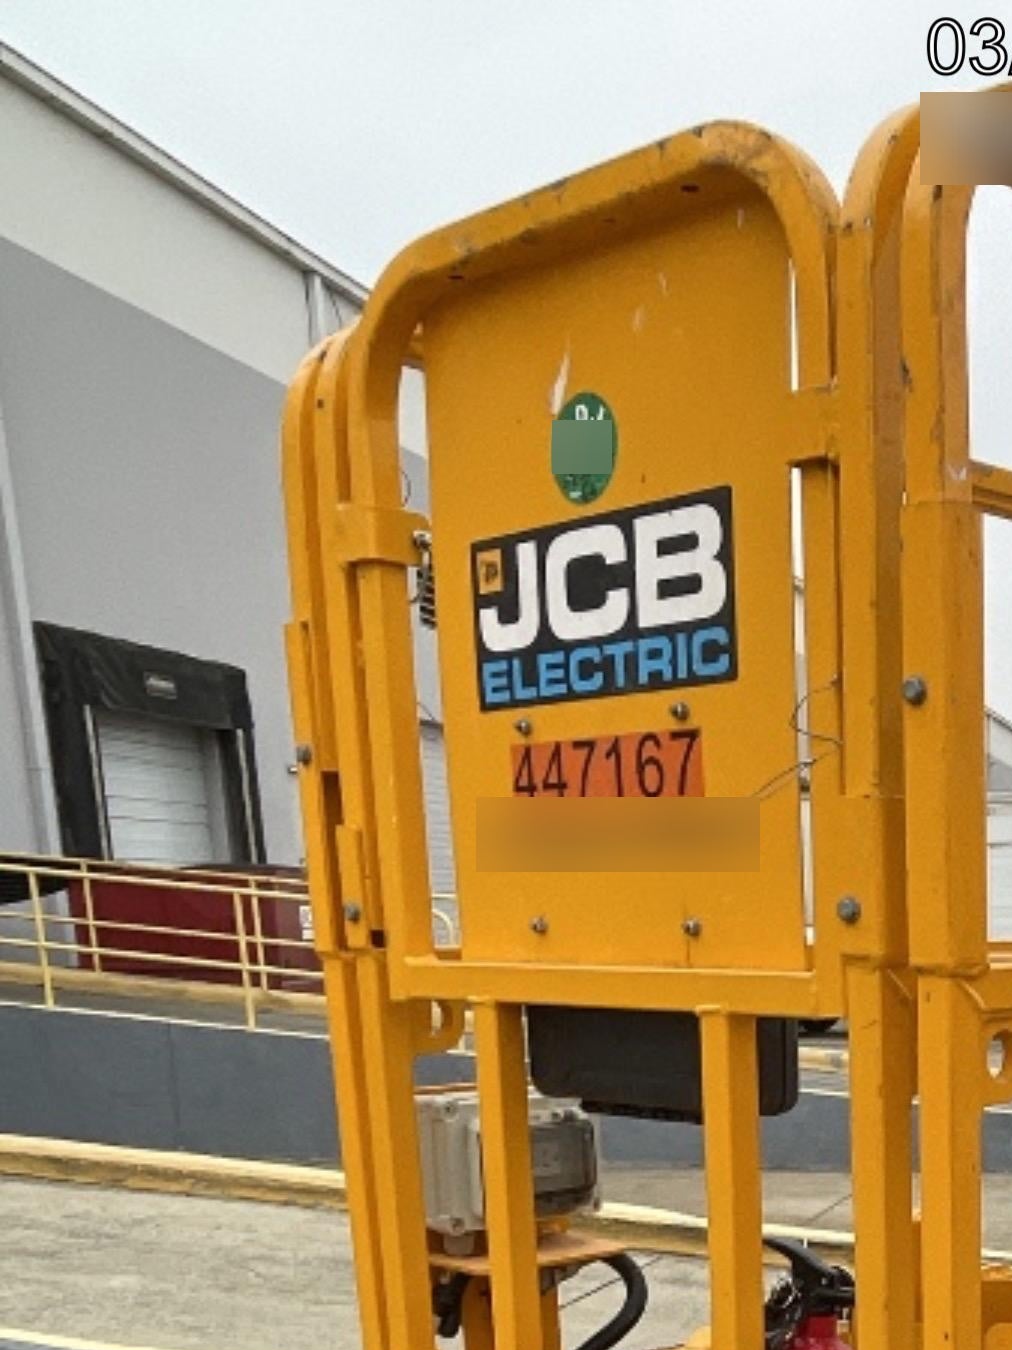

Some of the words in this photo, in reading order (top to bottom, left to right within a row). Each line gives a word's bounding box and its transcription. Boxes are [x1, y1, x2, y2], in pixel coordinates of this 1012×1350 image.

[479, 503, 727, 653] JCB
[482, 626, 731, 706] ELECTRIC
[513, 731, 700, 798] 447167
